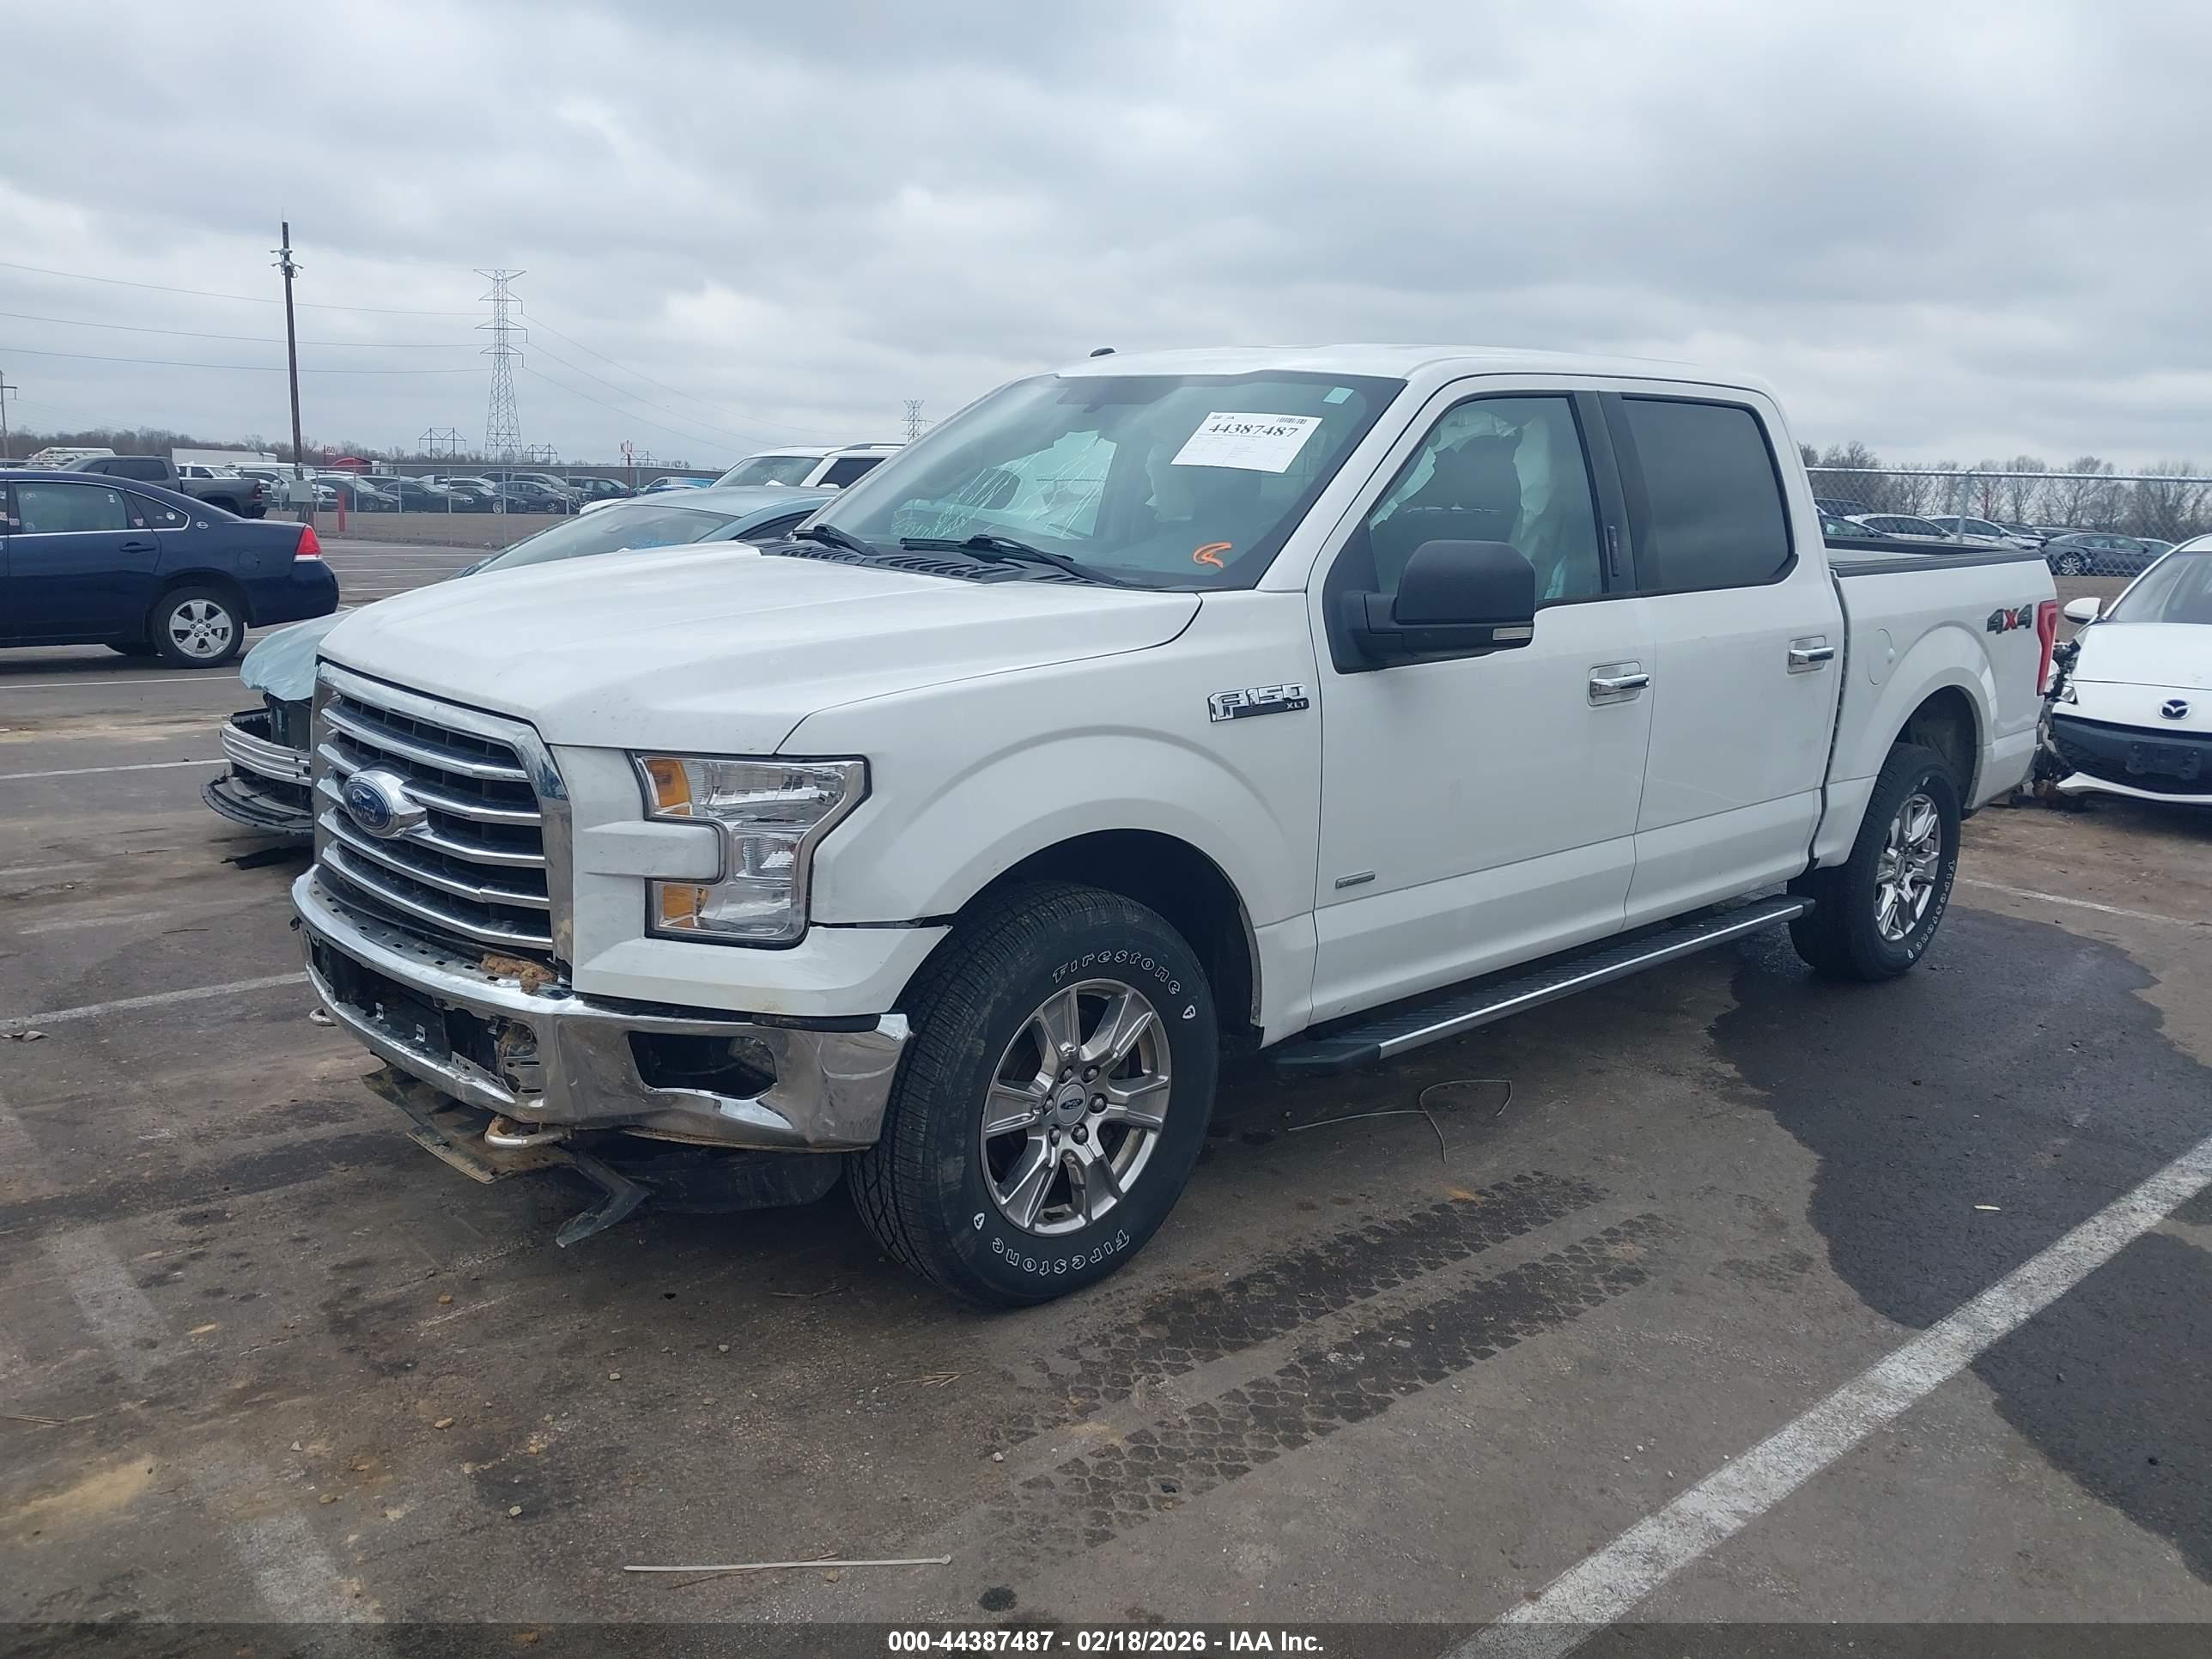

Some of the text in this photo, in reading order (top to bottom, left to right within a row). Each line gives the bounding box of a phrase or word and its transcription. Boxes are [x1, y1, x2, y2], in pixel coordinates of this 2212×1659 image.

[1208, 423, 1299, 438] 44387487
[1286, 701, 1306, 709] XLT
[350, 787, 380, 824] Ford
[1052, 950, 1182, 995] Firestone
[991, 1229, 1131, 1277] Firestone
